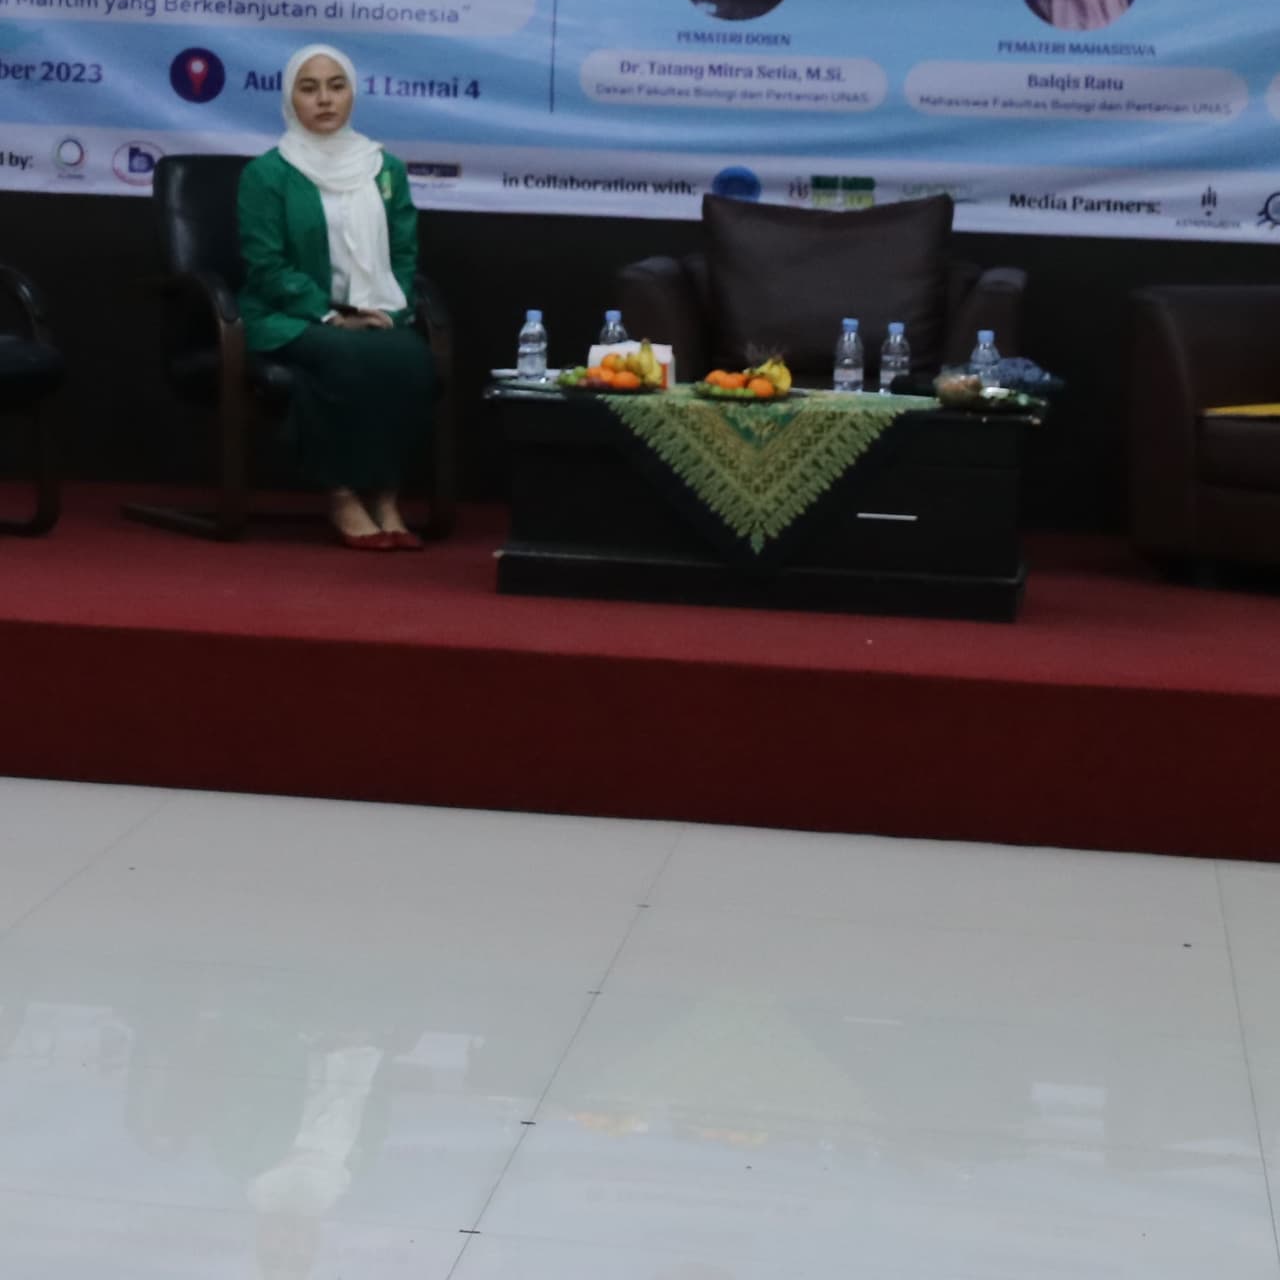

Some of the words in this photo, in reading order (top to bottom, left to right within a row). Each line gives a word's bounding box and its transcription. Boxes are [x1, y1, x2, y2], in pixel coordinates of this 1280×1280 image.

[324, 0, 343, 19] di
[677, 30, 744, 45] PEMATERI
[745, 32, 792, 47] DOSEN
[998, 39, 1066, 55] PEMATERI
[1068, 41, 1157, 57] MAHASISWA
[41, 60, 104, 83] 2023
[648, 60, 705, 81] Tatang
[708, 62, 754, 78] Mitra
[756, 64, 803, 83] Setia,
[1027, 72, 1080, 92] Balqis
[1084, 74, 1124, 91] Ratu
[243, 70, 284, 91] Aul
[364, 74, 376, 96] 1
[383, 74, 460, 98] Lantai
[463, 80, 481, 100] 4
[595, 82, 635, 95] Dekan
[637, 83, 690, 98] Fakultas
[693, 84, 737, 102] Biologi
[739, 86, 764, 100] dan
[766, 88, 828, 103] Pertanian
[830, 90, 870, 104] UNAS
[919, 95, 989, 108] Mahasiswa
[992, 96, 1048, 110] Fakultas
[1051, 98, 1097, 115] Biologi
[1099, 100, 1124, 113] dan
[1126, 100, 1189, 114] Pertanian
[1192, 102, 1232, 116] UNAS
[8, 149, 34, 171] by:
[502, 172, 519, 188] in
[522, 173, 648, 193] Collaboration
[652, 178, 697, 196] with:
[1009, 192, 1067, 211] Media
[1072, 194, 1161, 216] Partners:
